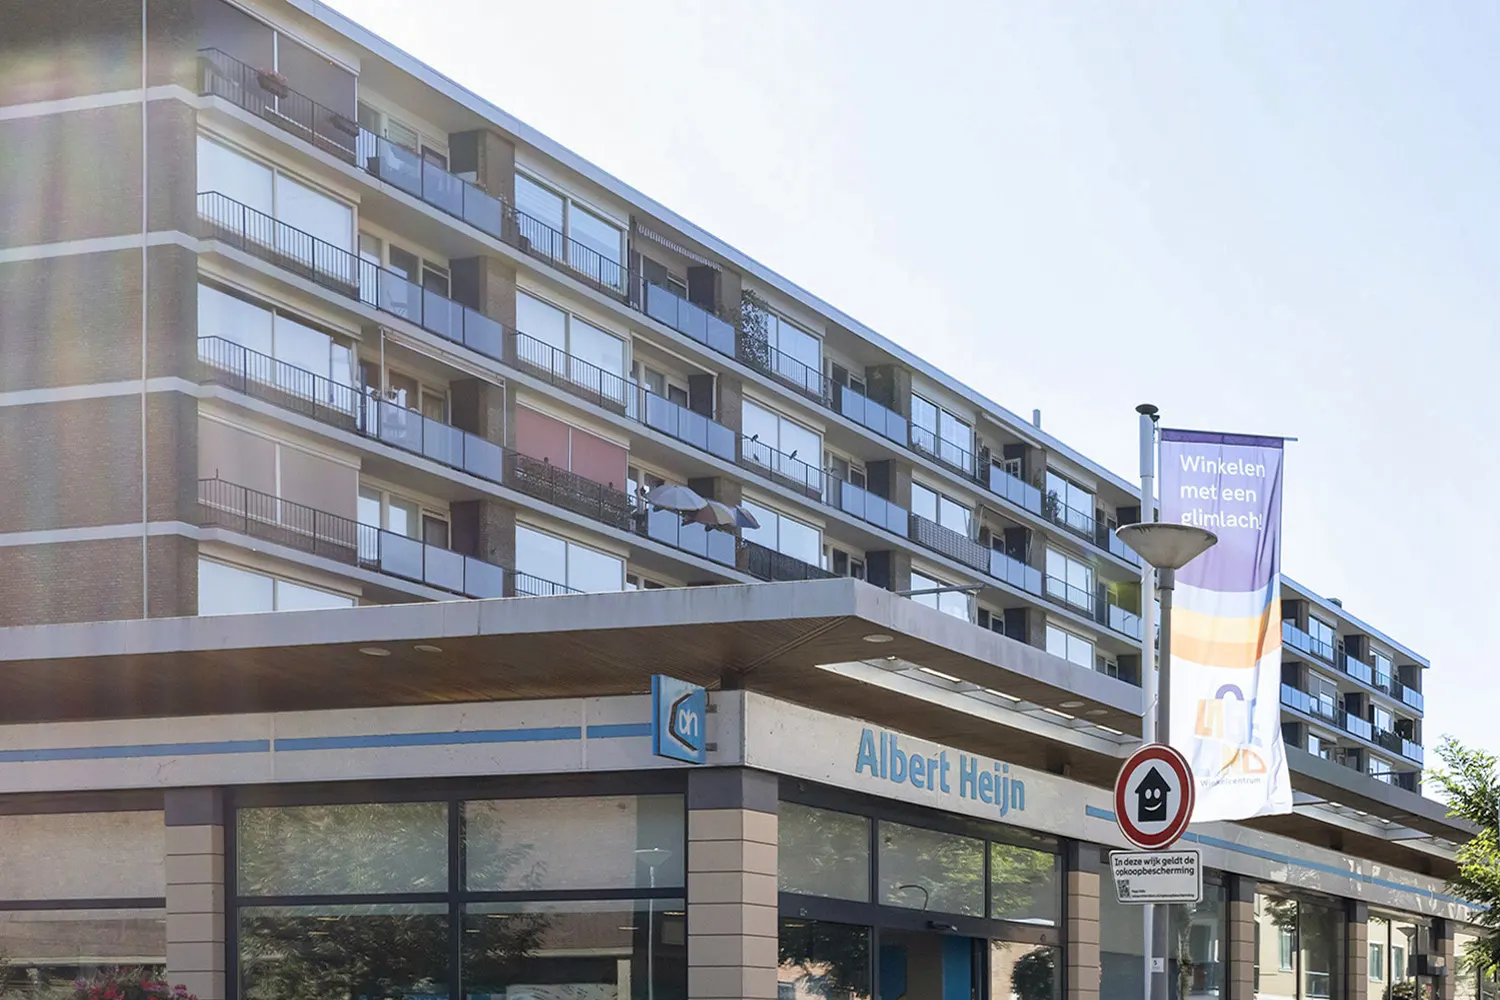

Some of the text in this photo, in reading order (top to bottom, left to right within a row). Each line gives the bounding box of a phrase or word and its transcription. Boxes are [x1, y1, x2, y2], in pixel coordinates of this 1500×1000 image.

[1180, 454, 1265, 478] Winkelen
[1180, 484, 1257, 502] met een
[1181, 508, 1263, 530] glimlach!
[855, 728, 1026, 818] Albert Heijn
[1114, 856, 1195, 867] In deze wijk geldt de
[1115, 866, 1195, 877] opkoopbescherming
